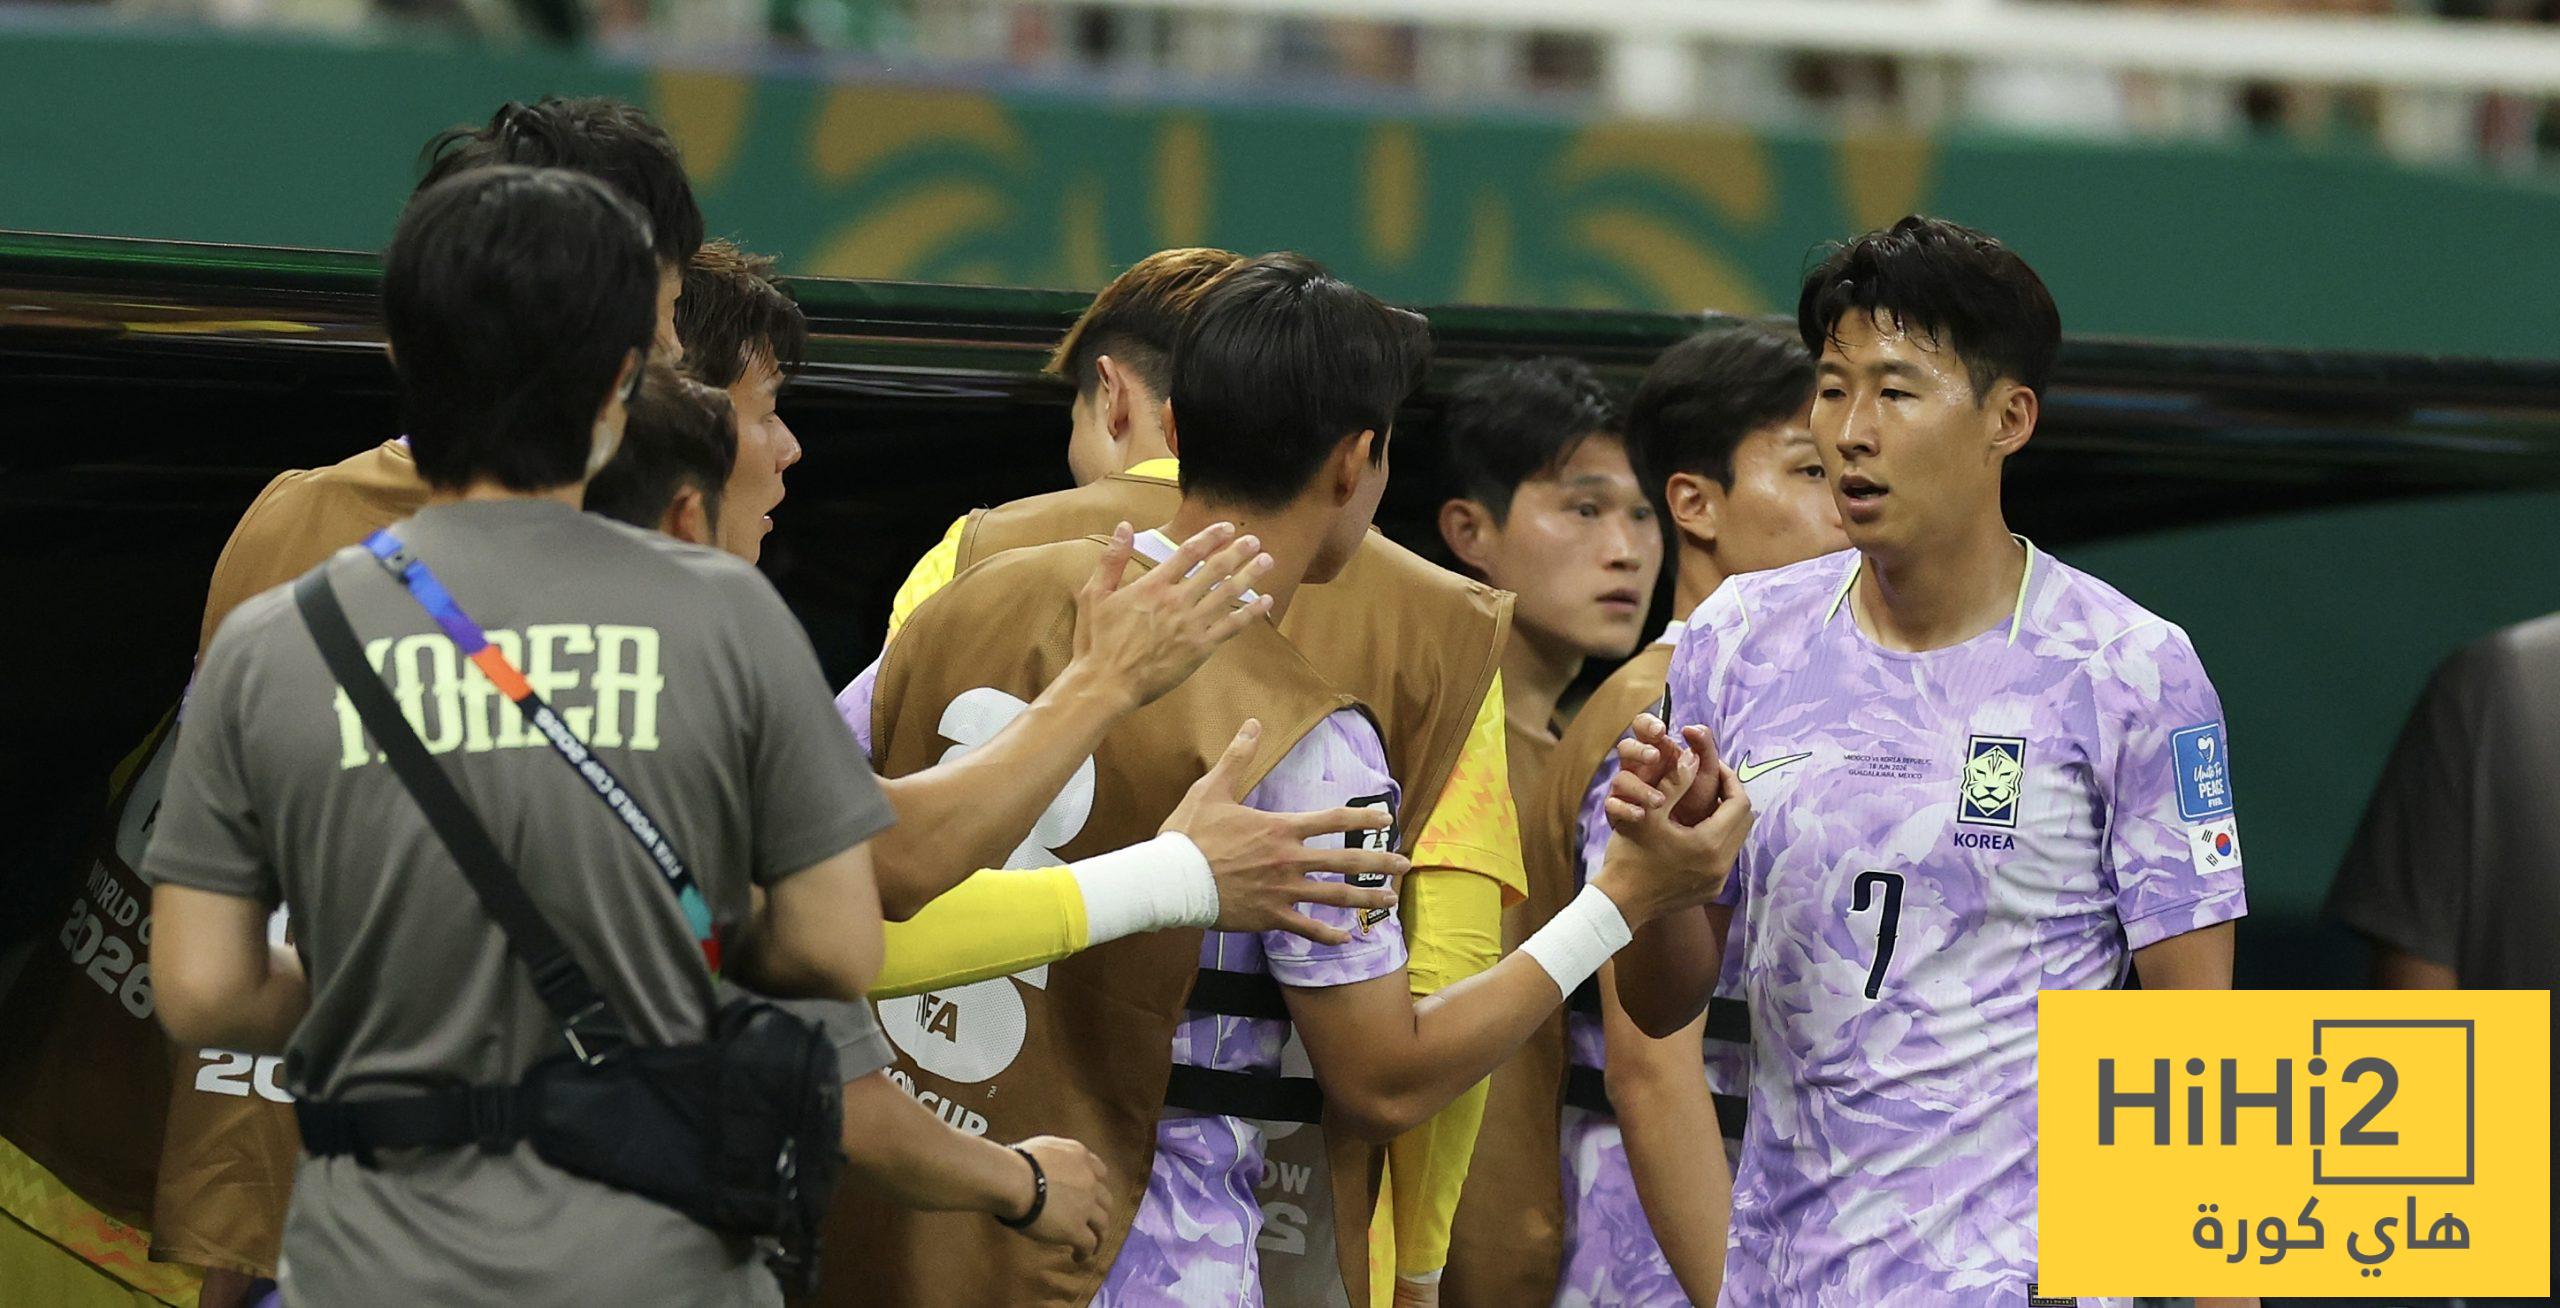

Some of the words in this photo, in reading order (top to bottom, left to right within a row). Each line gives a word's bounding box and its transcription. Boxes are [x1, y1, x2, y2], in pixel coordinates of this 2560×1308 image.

[2199, 778, 2225, 799] PEACE
[1954, 832, 2015, 850] KOREA
[58, 897, 153, 1019] 2026
[1847, 870, 1905, 1002] 7
